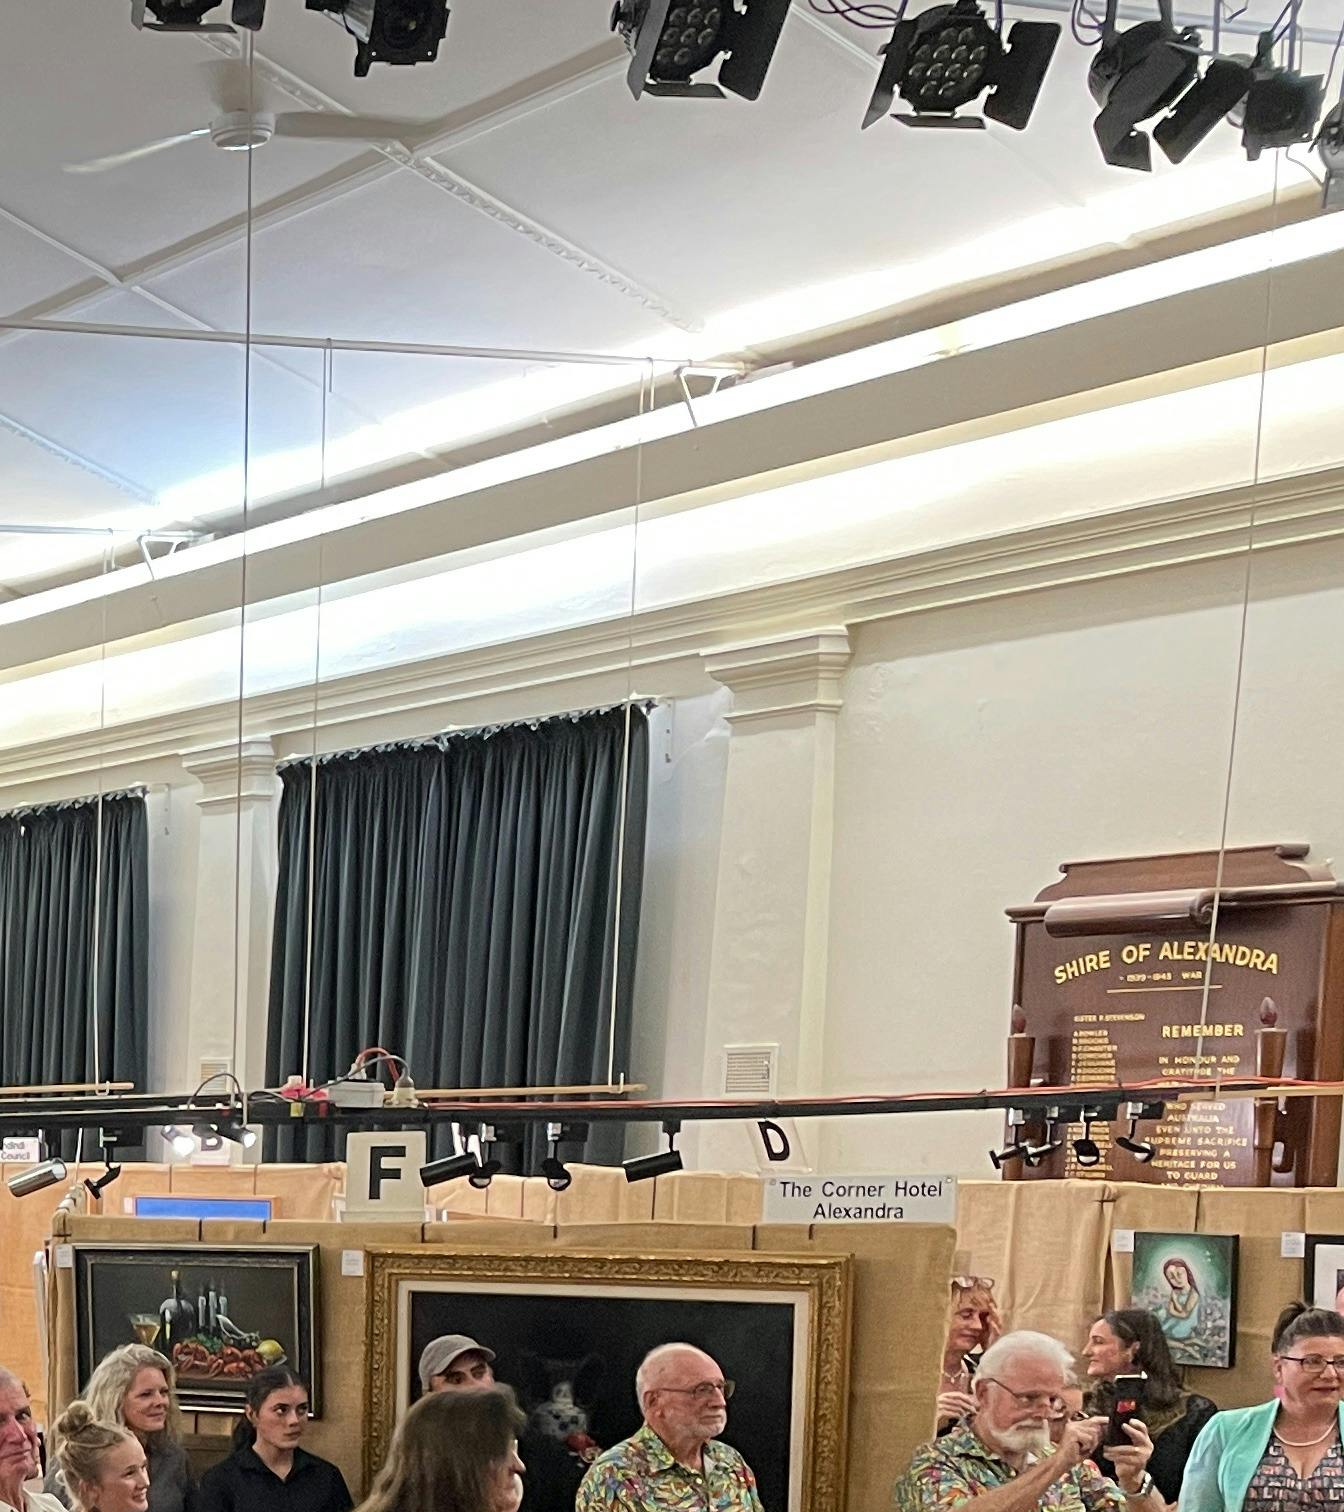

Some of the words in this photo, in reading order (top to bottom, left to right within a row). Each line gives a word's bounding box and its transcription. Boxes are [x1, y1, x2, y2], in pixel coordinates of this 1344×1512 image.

[1054, 950, 1112, 984] SHIRE
[1122, 943, 1152, 964] OF
[1158, 941, 1279, 975] ALEXANDRA
[1181, 971, 1203, 980] WAR
[1162, 1024, 1244, 1038] REMEMBER
[1174, 1056, 1217, 1065] HONOUR
[1221, 1055, 1241, 1064] AND
[1156, 1125, 1180, 1135] EVEN
[1215, 1126, 1235, 1135] THE
[757, 1120, 791, 1162] D
[1197, 1137, 1248, 1147] SACRIFICE
[0, 1151, 31, 1160] Council
[1159, 1148, 1218, 1158] PRESERVING
[1223, 1150, 1231, 1159] A
[1151, 1159, 1196, 1169] HERITAGE
[1200, 1160, 1221, 1170] FOR
[1223, 1160, 1237, 1170] US
[369, 1145, 407, 1200] F
[1166, 1171, 1181, 1180] TO
[1184, 1171, 1219, 1181] GUARD
[779, 1181, 813, 1198] The
[821, 1181, 885, 1198] Corner
[894, 1180, 943, 1197] Hotel
[812, 1202, 905, 1220] Alexandra
